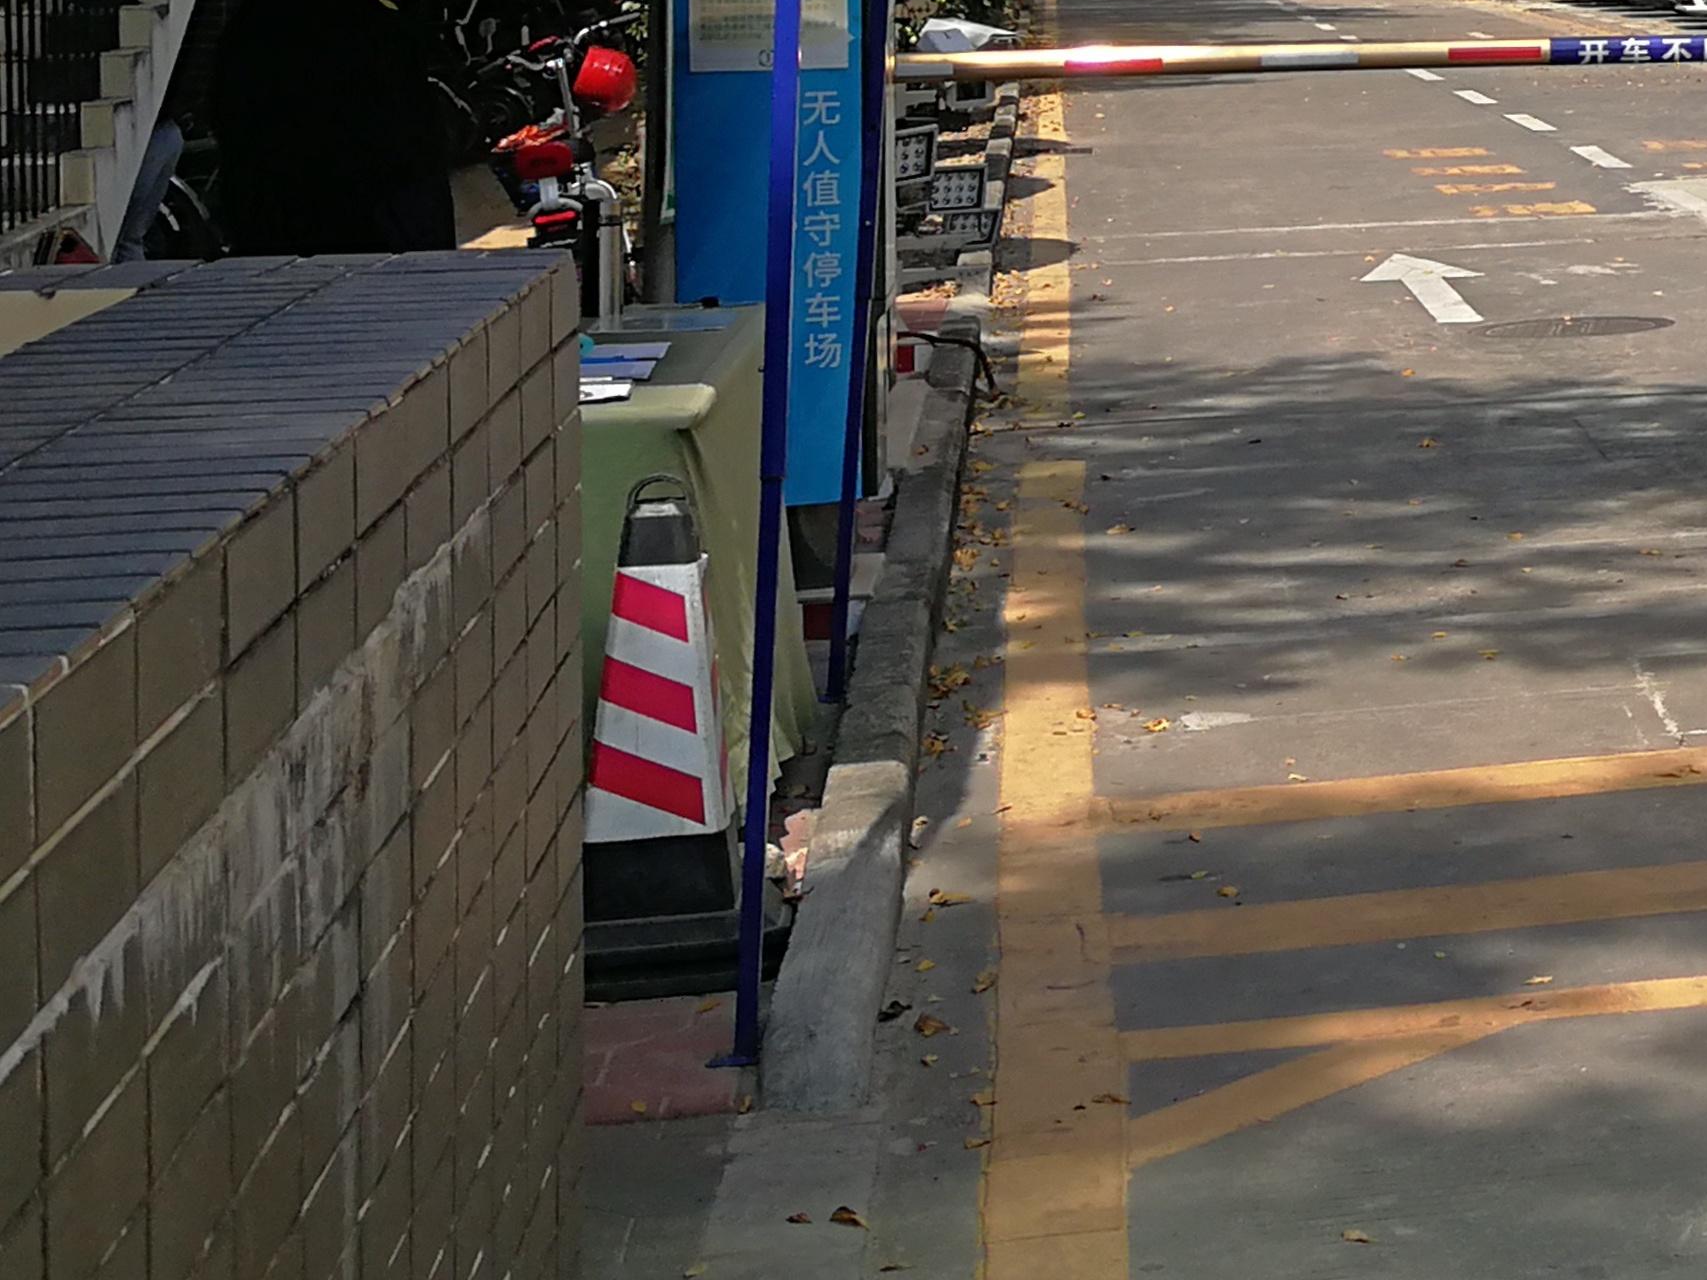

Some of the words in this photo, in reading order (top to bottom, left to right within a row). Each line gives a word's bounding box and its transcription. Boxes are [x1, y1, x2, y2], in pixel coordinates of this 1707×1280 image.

[802, 90, 843, 370] 无人值守停车场
